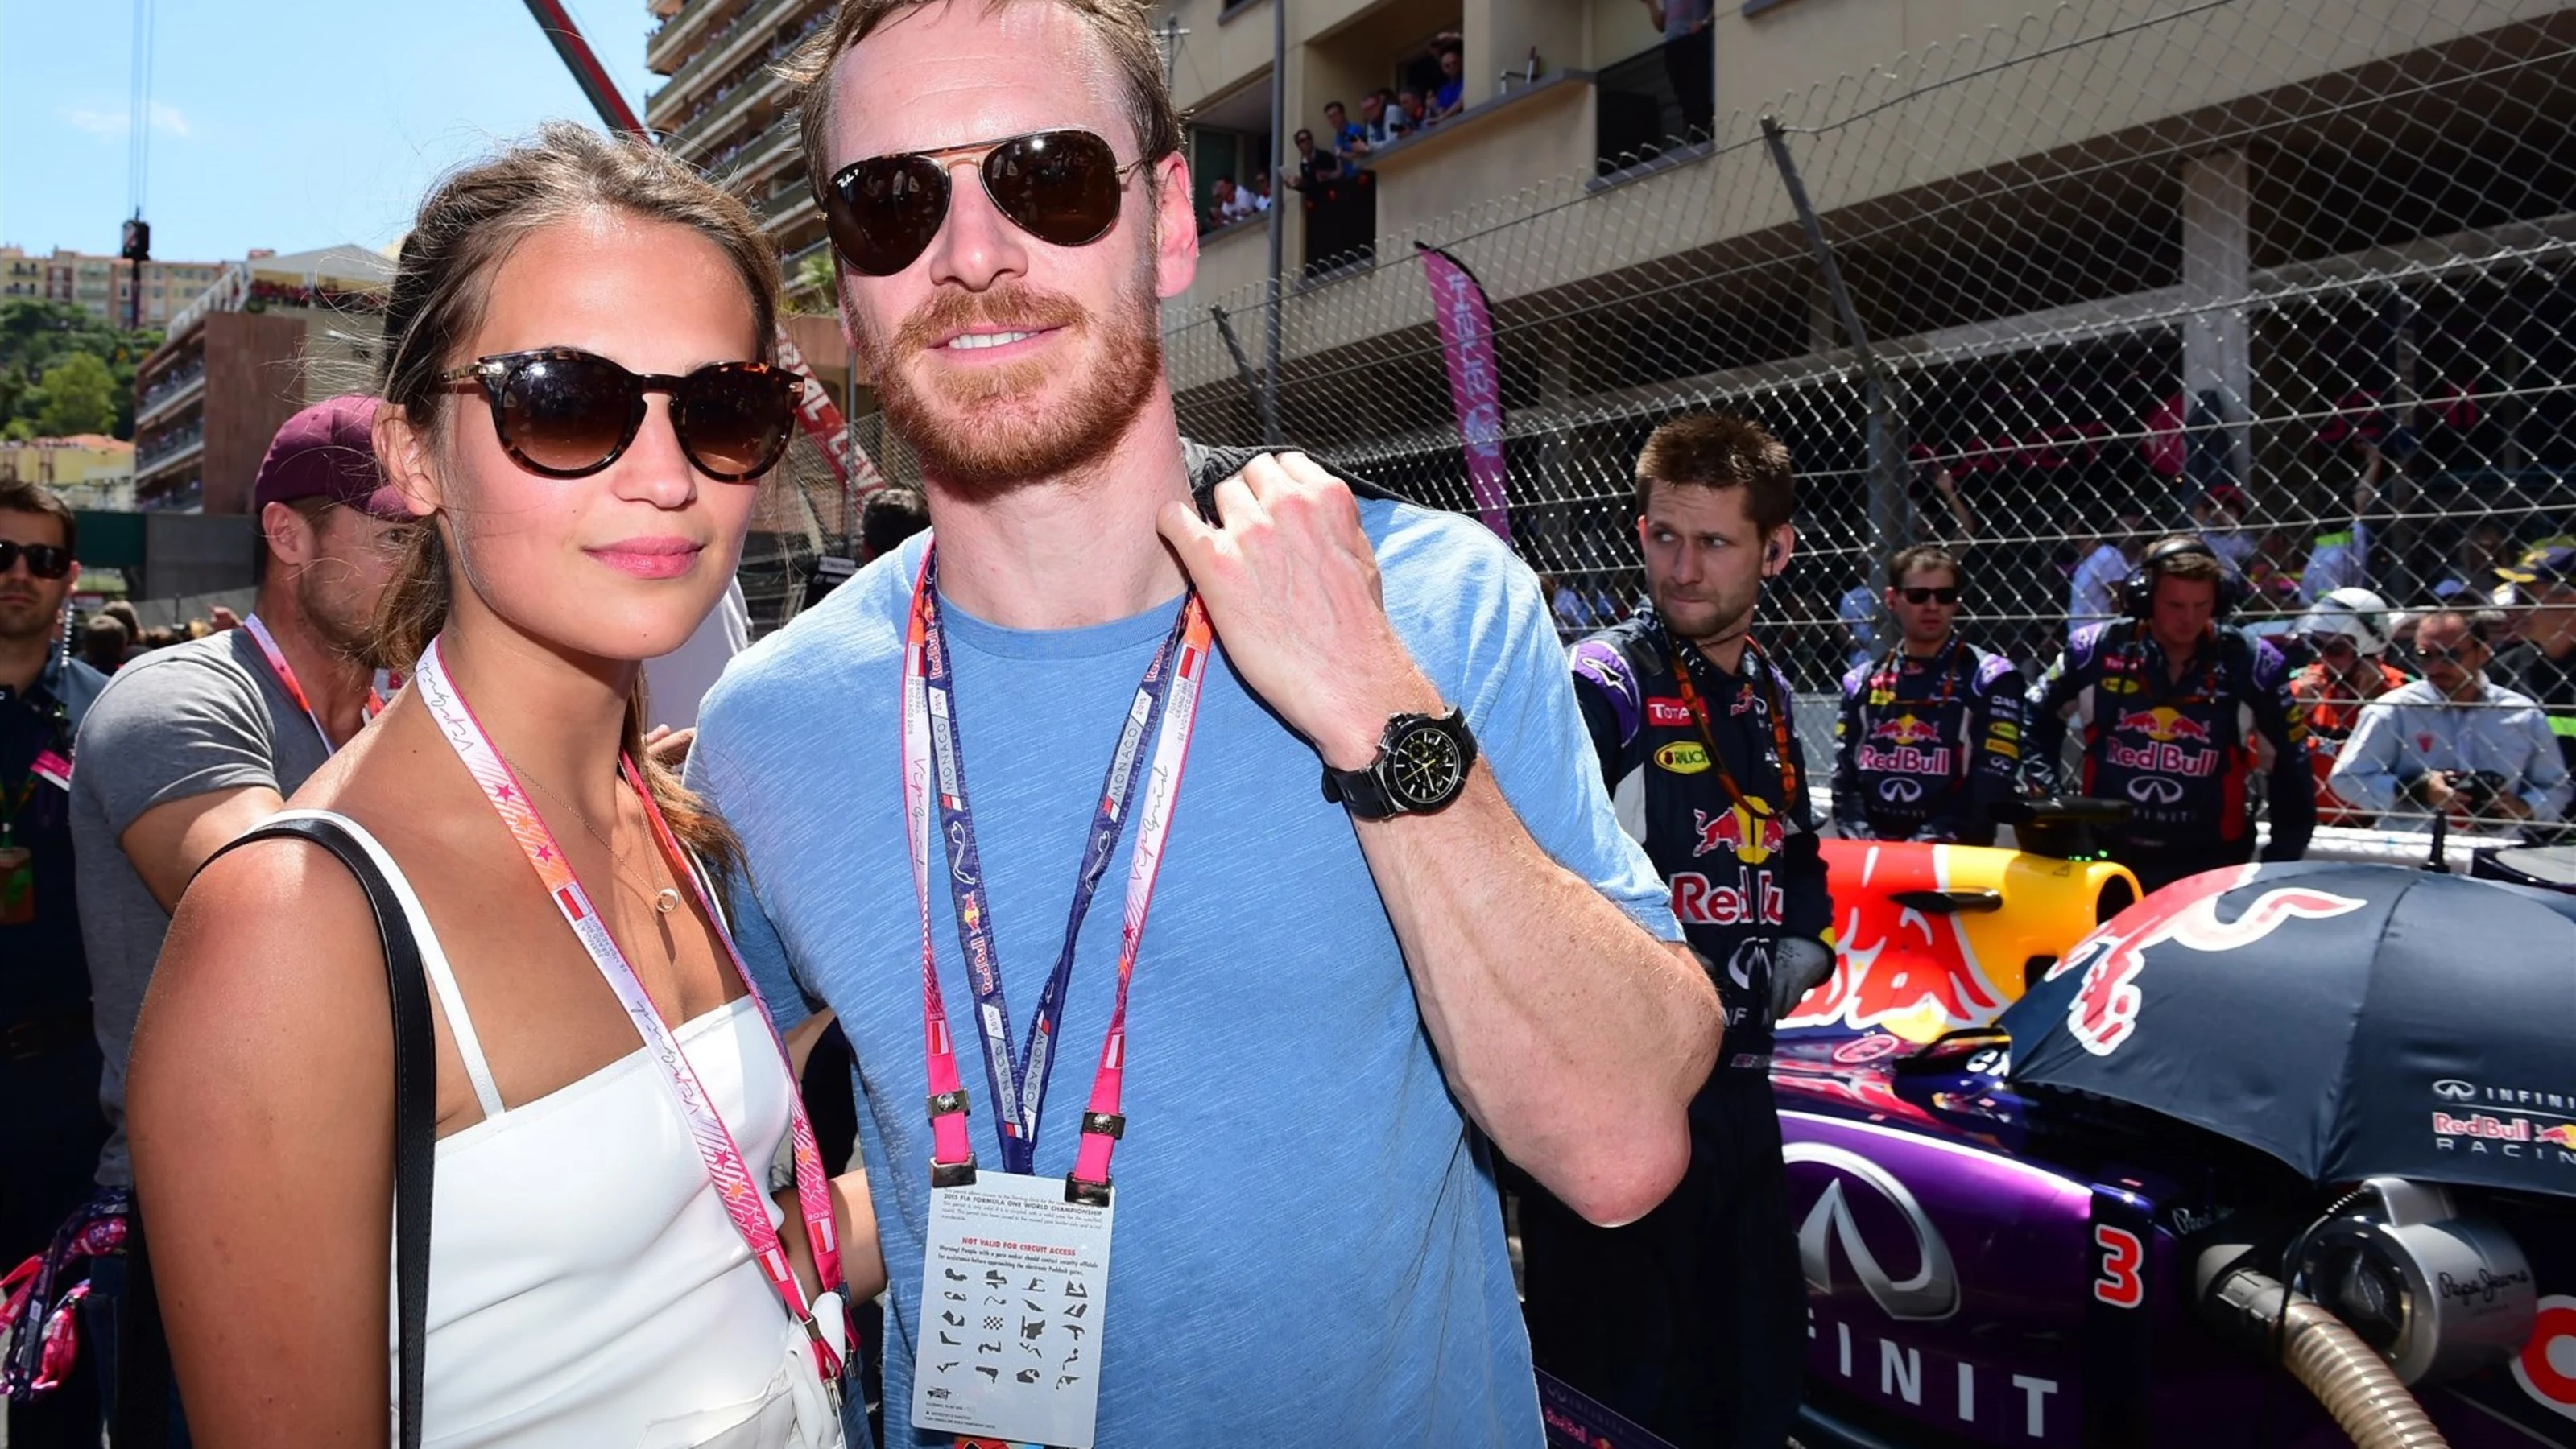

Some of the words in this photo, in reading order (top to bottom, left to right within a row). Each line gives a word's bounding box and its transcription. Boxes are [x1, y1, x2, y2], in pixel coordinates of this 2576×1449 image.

[937, 723, 953, 791] MONACO
[1112, 727, 1138, 797] MONACO
[995, 1046, 1016, 1118] MONACO
[1026, 1034, 1044, 1102] MONACO
[973, 1197, 1005, 1206] FORMULA
[1051, 1206, 1102, 1216] CHAMPIONSHIP
[980, 1239, 1001, 1248] VALID
[1019, 1244, 1047, 1253] CIRCUIT
[1049, 1247, 1076, 1257] ACCESS
[2094, 1224, 2144, 1310] 3
